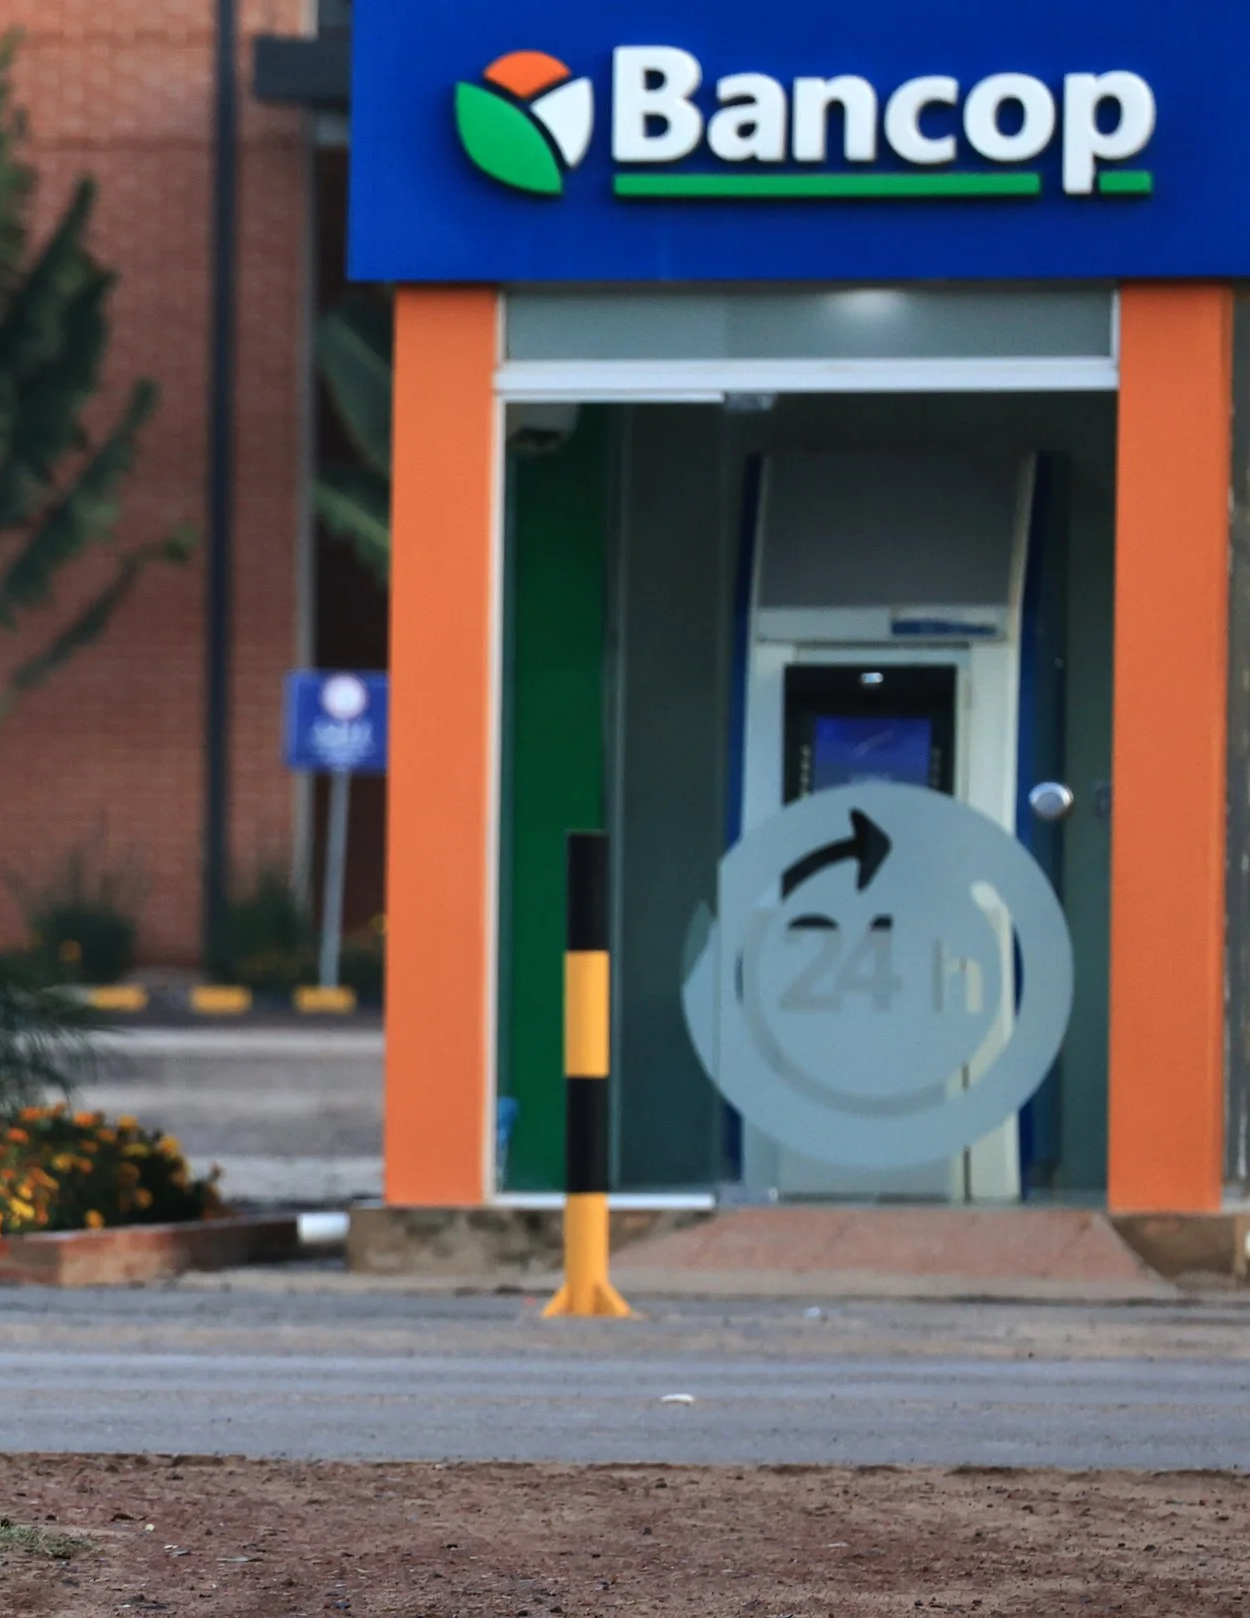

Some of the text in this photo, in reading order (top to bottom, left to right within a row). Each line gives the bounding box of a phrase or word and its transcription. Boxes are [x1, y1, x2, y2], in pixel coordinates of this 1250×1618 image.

[612, 44, 1156, 195] Bancop
[778, 913, 983, 1013] 24 h
